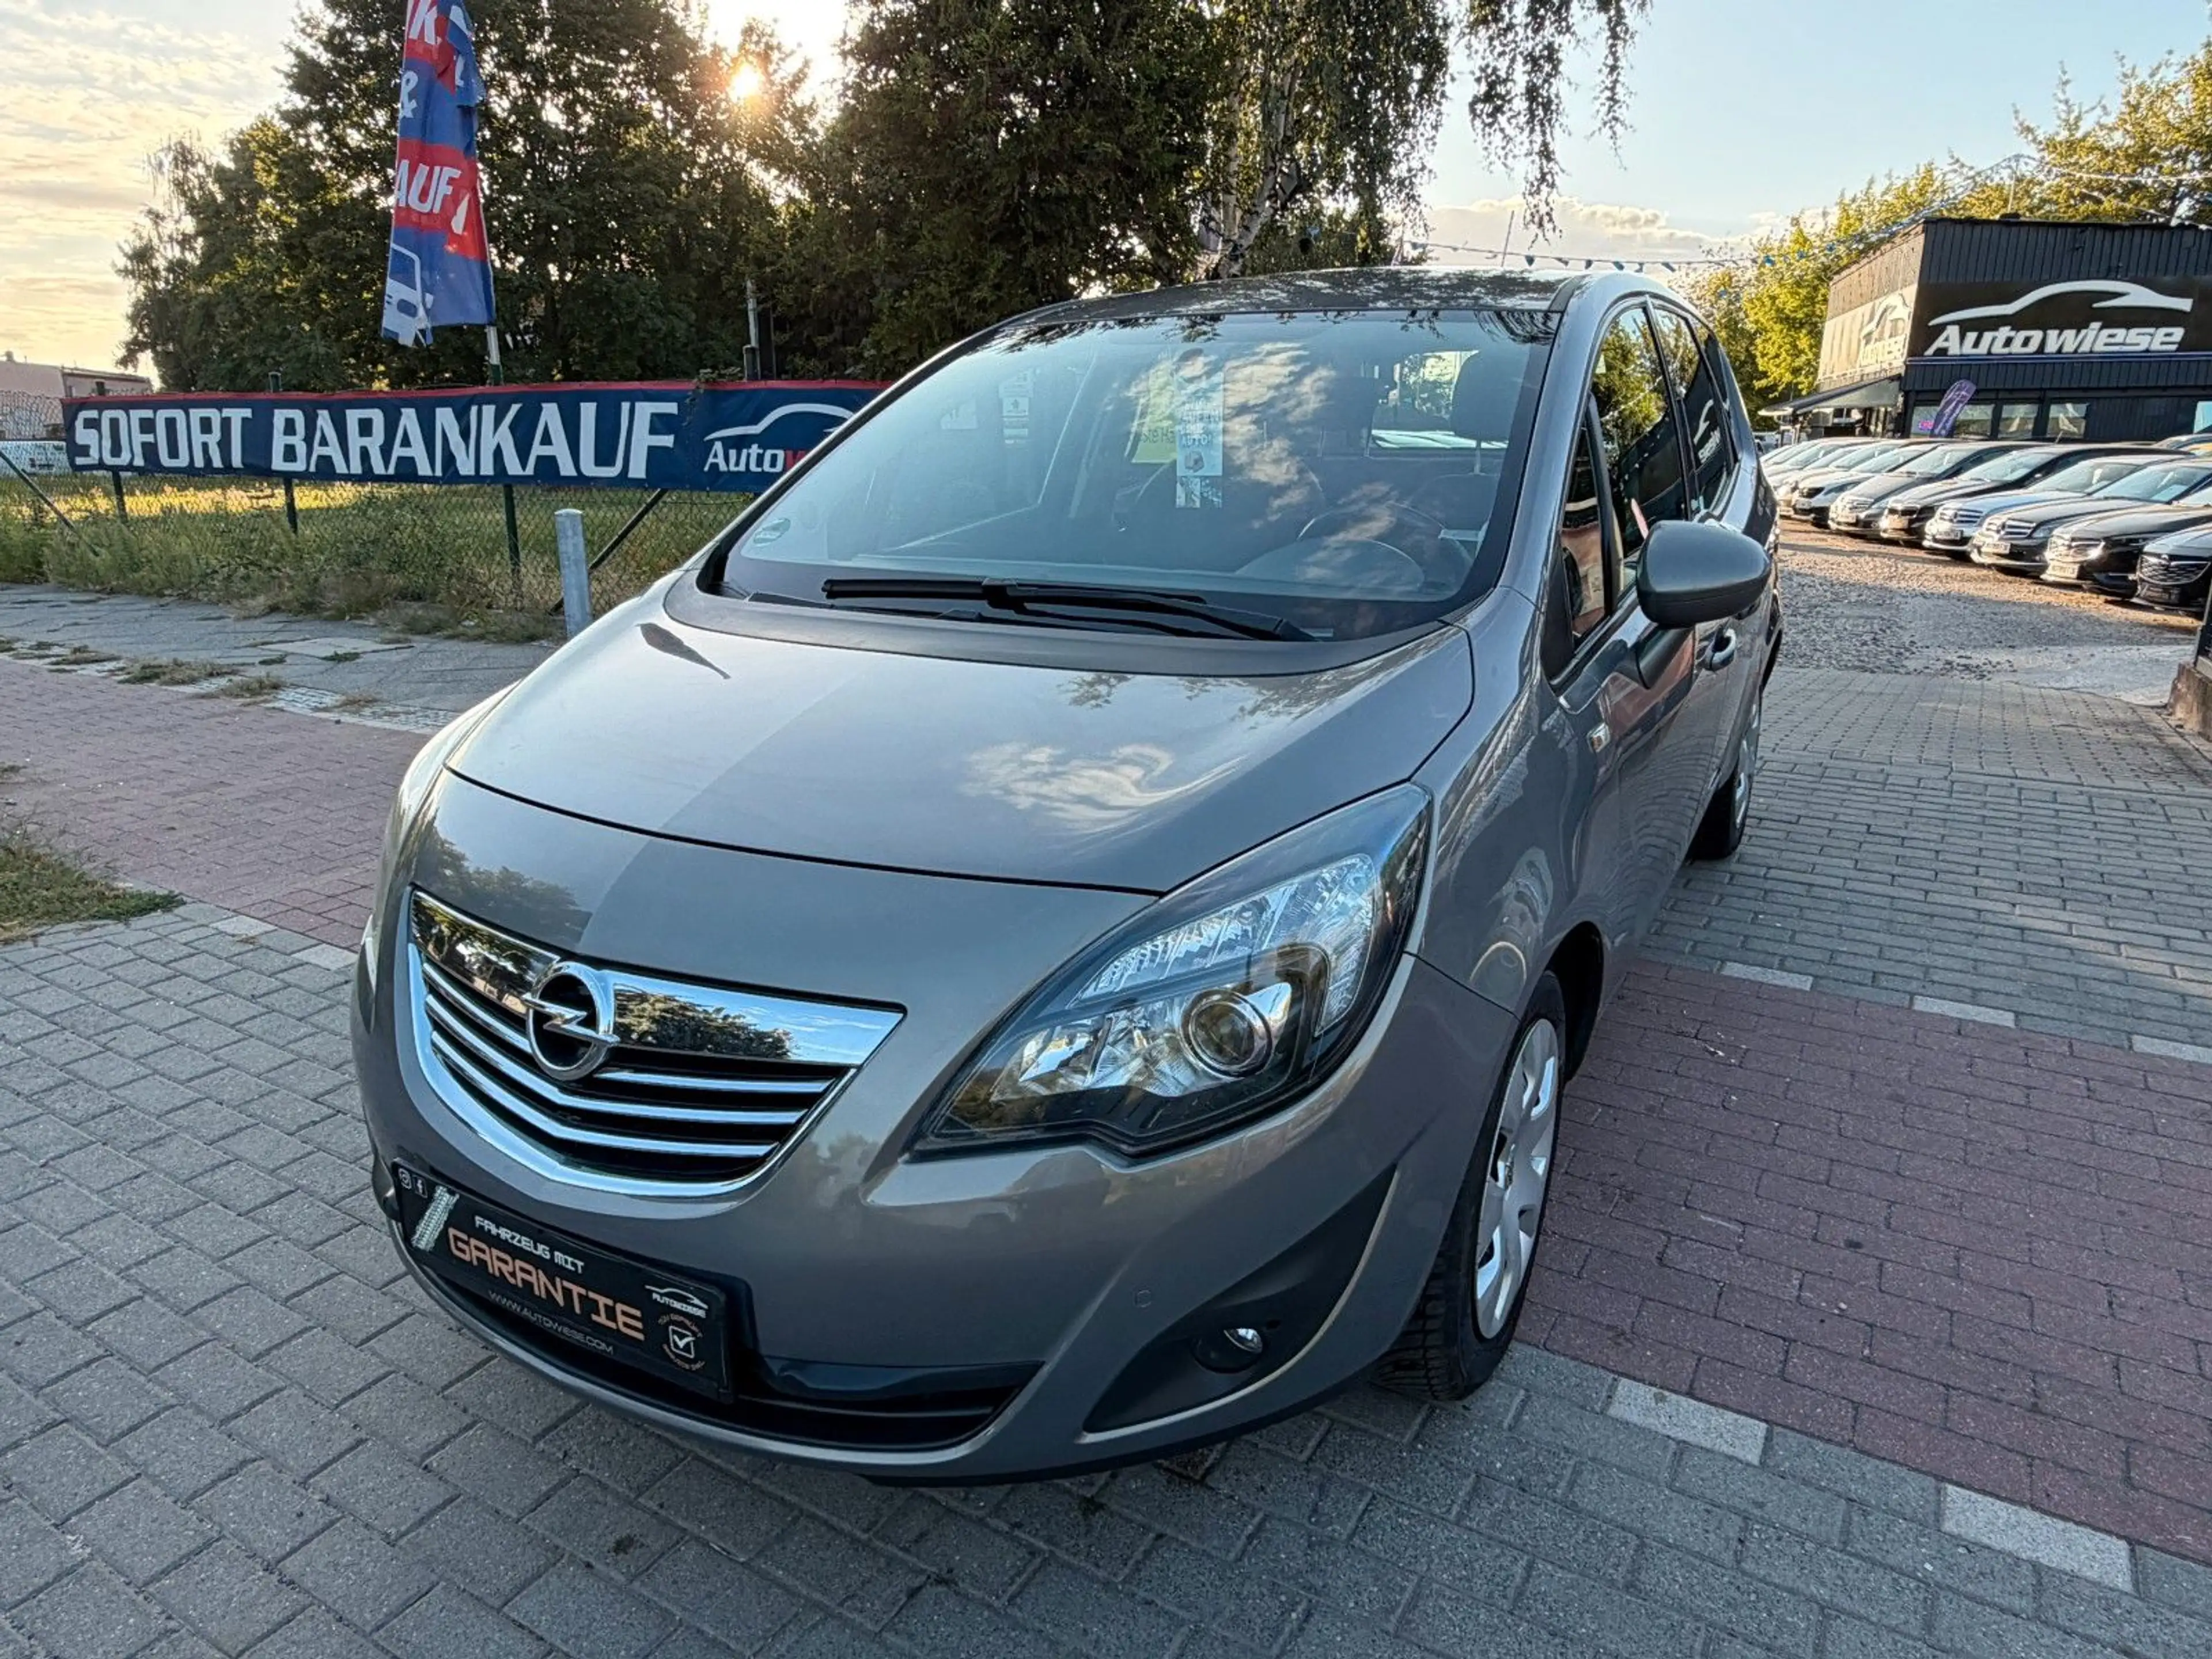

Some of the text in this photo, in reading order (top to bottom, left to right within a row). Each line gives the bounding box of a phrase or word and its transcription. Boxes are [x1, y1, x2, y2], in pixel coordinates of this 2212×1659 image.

[1923, 322, 2185, 357] Autowiese
[74, 402, 679, 479] SOFORT BARANKAUF
[474, 1215, 584, 1275] FAHRZEUG MIT
[448, 1226, 646, 1341] GARANTIE
